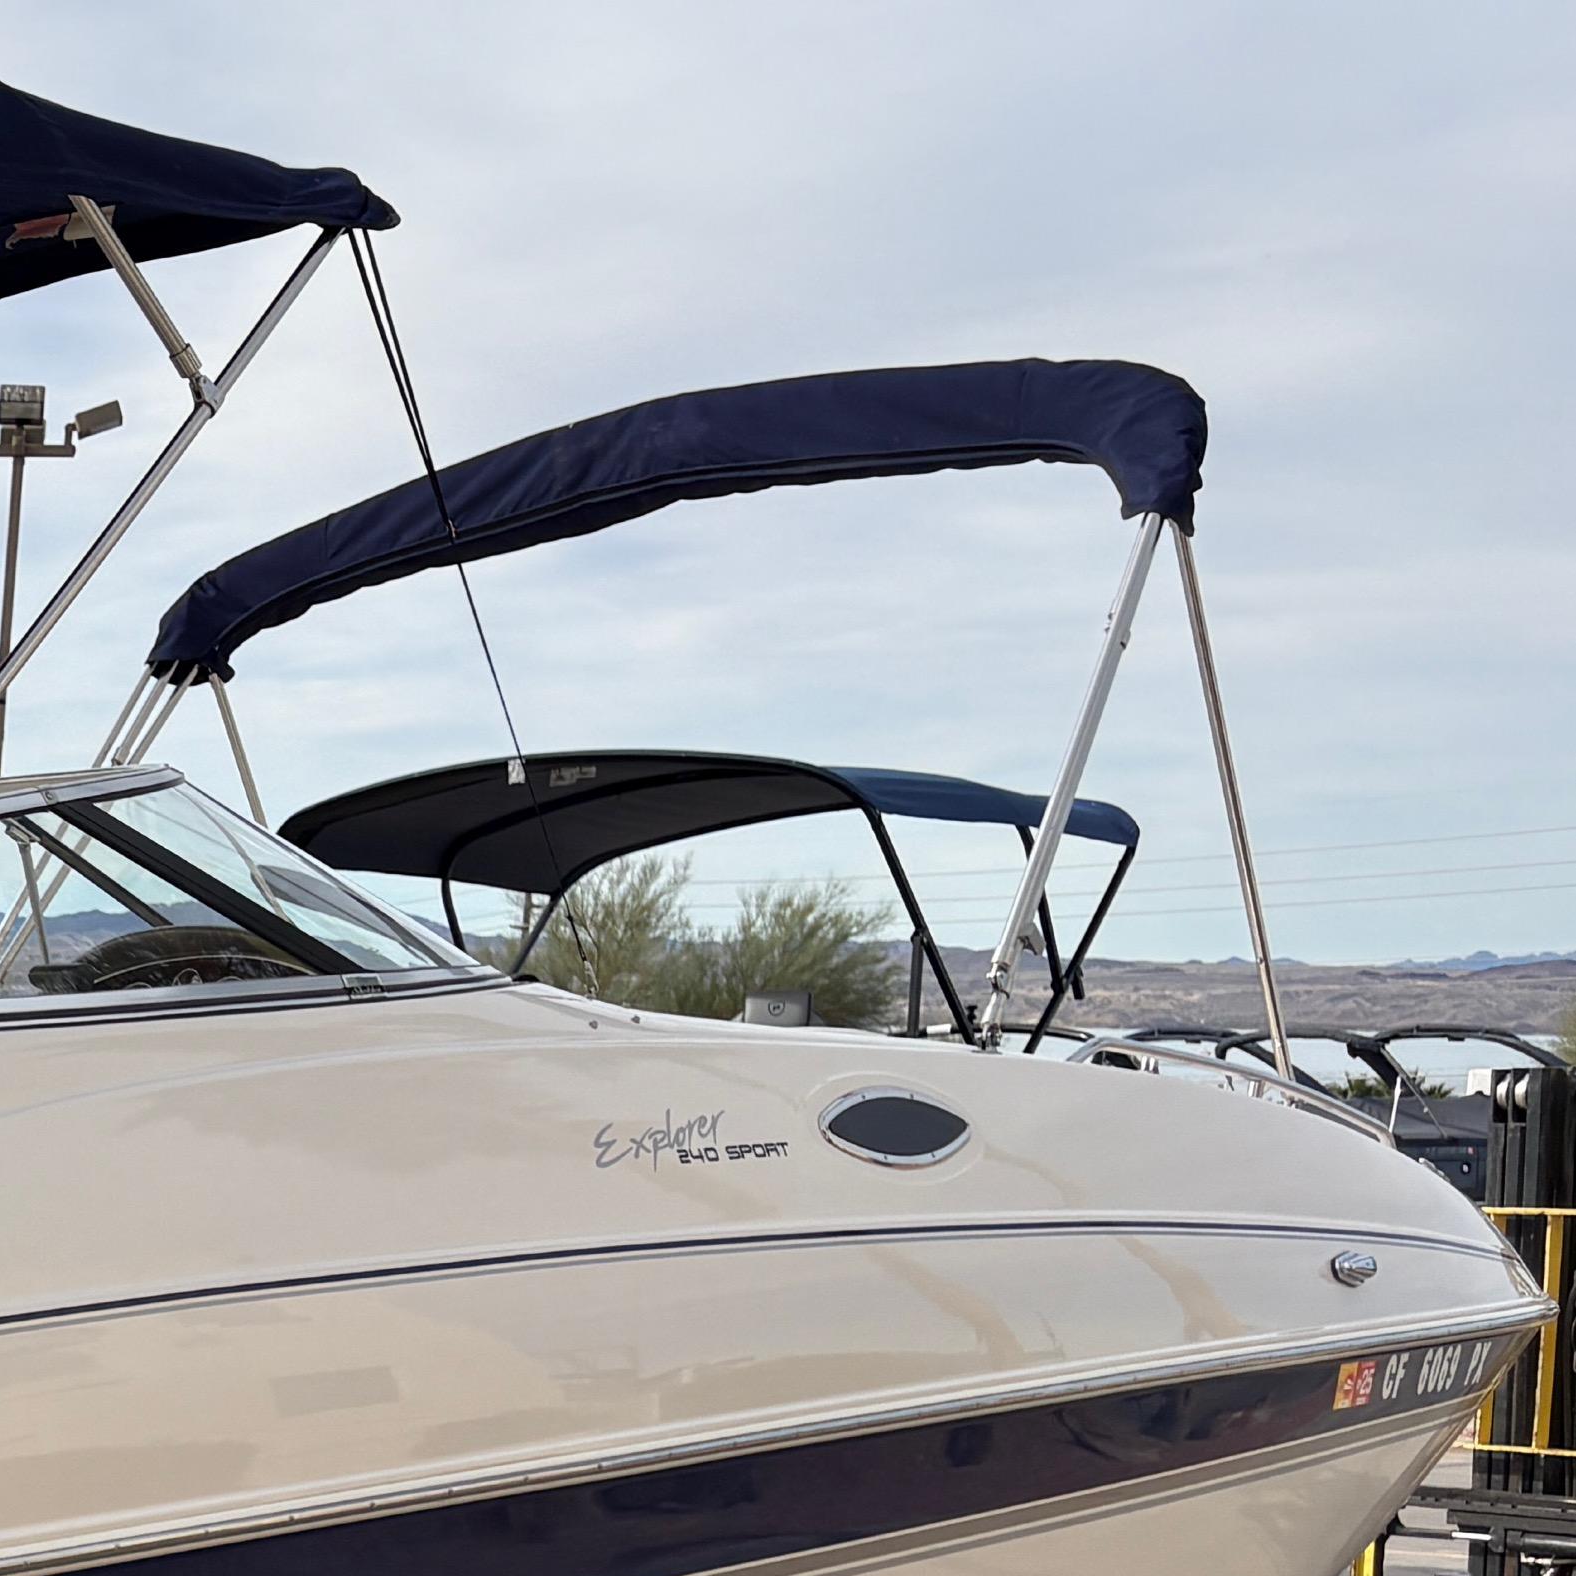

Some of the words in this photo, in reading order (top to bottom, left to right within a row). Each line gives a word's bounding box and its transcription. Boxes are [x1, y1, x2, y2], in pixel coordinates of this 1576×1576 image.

[594, 1109, 725, 1172] Explorer
[676, 1147, 718, 1164] 240
[725, 1142, 790, 1160] SPORT
[1382, 1352, 1410, 1400] CF
